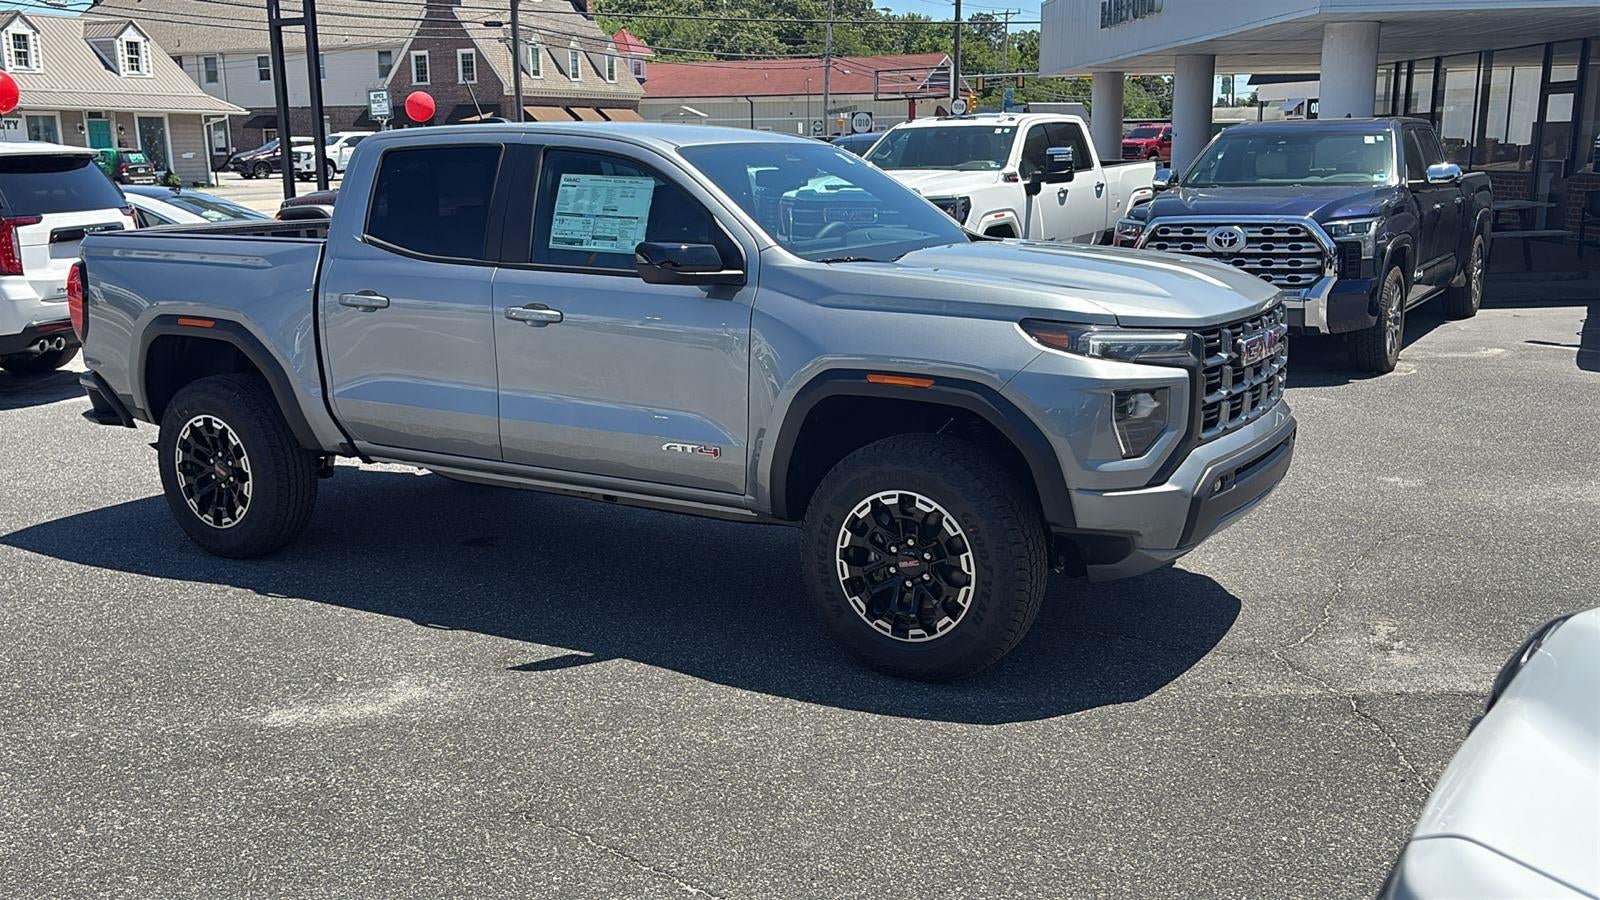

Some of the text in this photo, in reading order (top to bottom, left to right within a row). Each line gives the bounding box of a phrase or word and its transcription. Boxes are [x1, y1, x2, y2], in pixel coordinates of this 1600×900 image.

[854, 118, 870, 127] 1010
[661, 442, 721, 460] AT4
[898, 559, 920, 568] GMC
